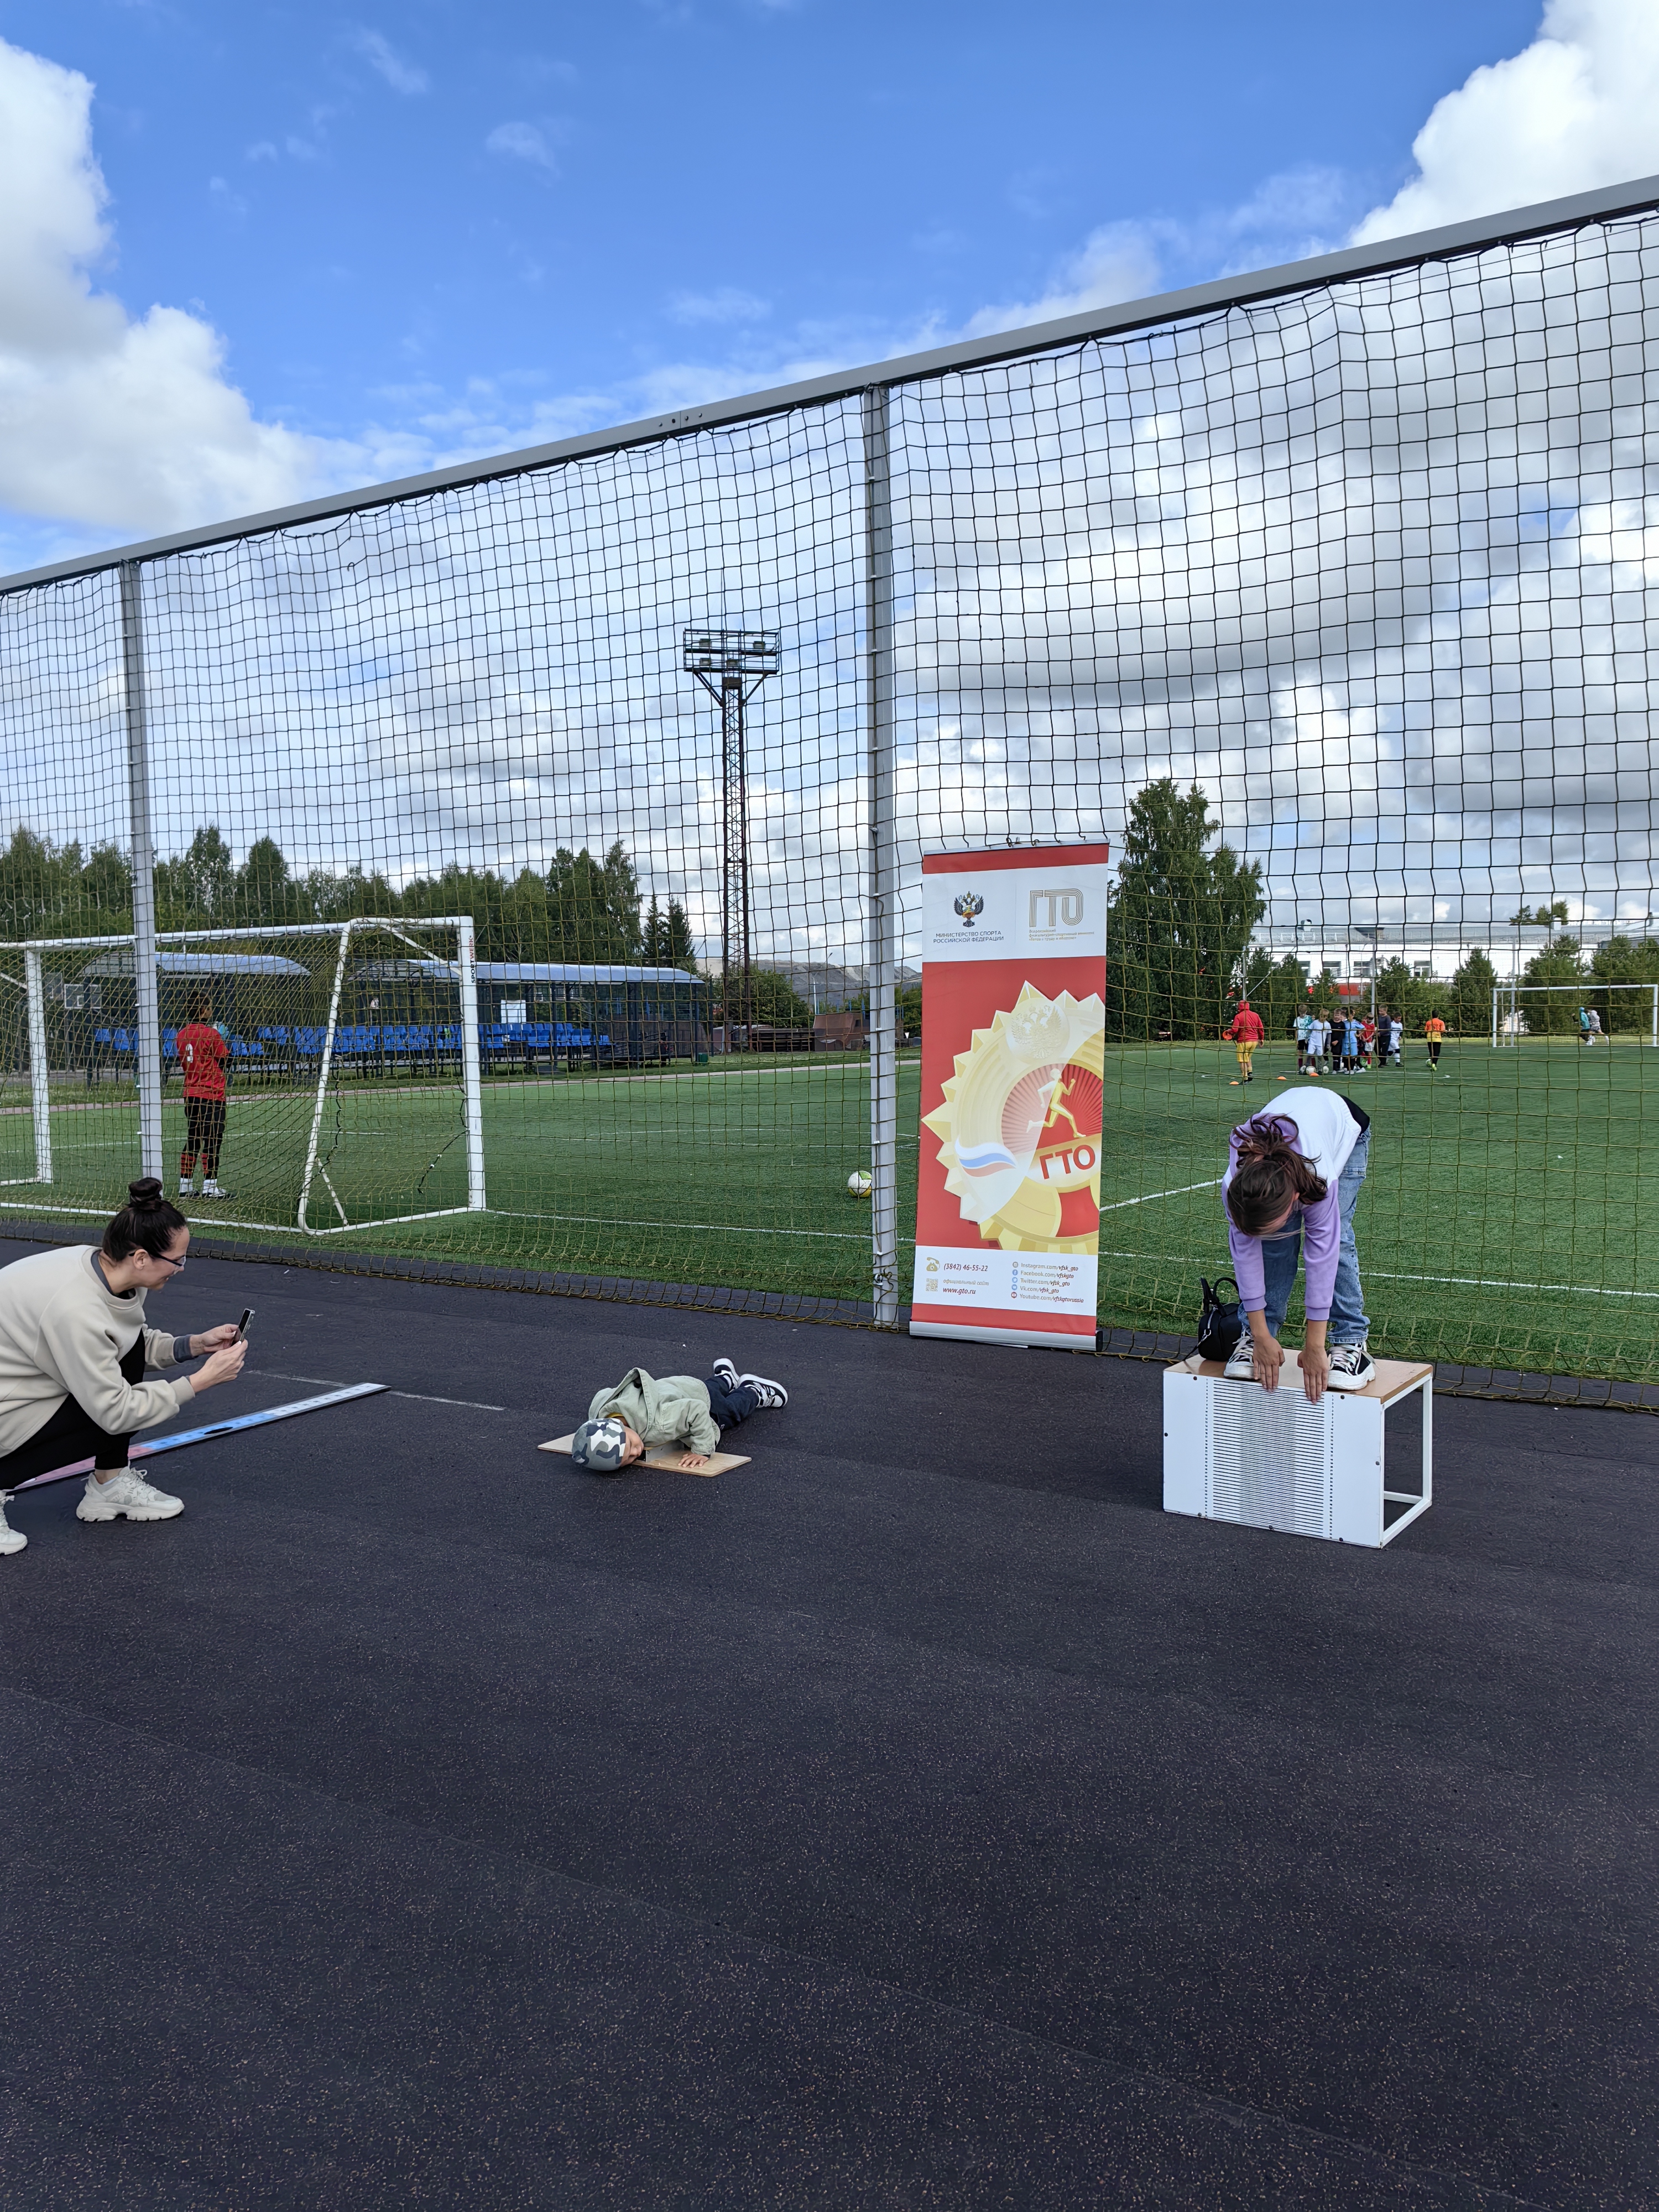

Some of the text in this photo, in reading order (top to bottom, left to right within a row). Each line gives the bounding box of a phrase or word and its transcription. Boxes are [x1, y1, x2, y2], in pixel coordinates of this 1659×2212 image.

[1029, 888, 1083, 927] ГТО
[1039, 1144, 1096, 1180] ГТО
[943, 1263, 962, 1271] (3842)
[1021, 1262, 1079, 1272] Instagram.com/vfsk_gto
[1020, 1278, 1070, 1287] Twitter.com/vfsk_gto
